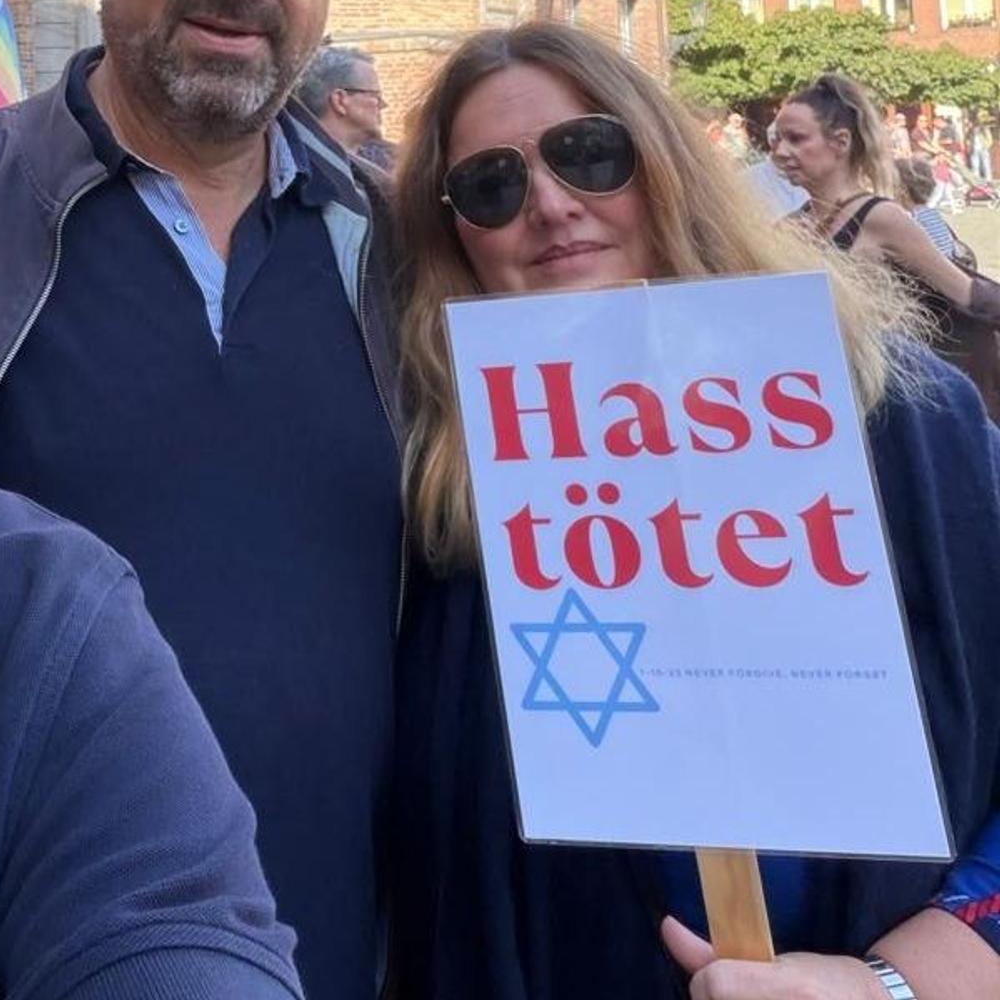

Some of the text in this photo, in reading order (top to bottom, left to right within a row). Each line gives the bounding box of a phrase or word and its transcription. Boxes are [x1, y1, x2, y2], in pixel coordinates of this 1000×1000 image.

[480, 361, 835, 462] Hass
[502, 482, 870, 591] tötet
[683, 667, 724, 679] NEVER
[789, 667, 832, 680] NEVER
[835, 667, 887, 680] FORGET
